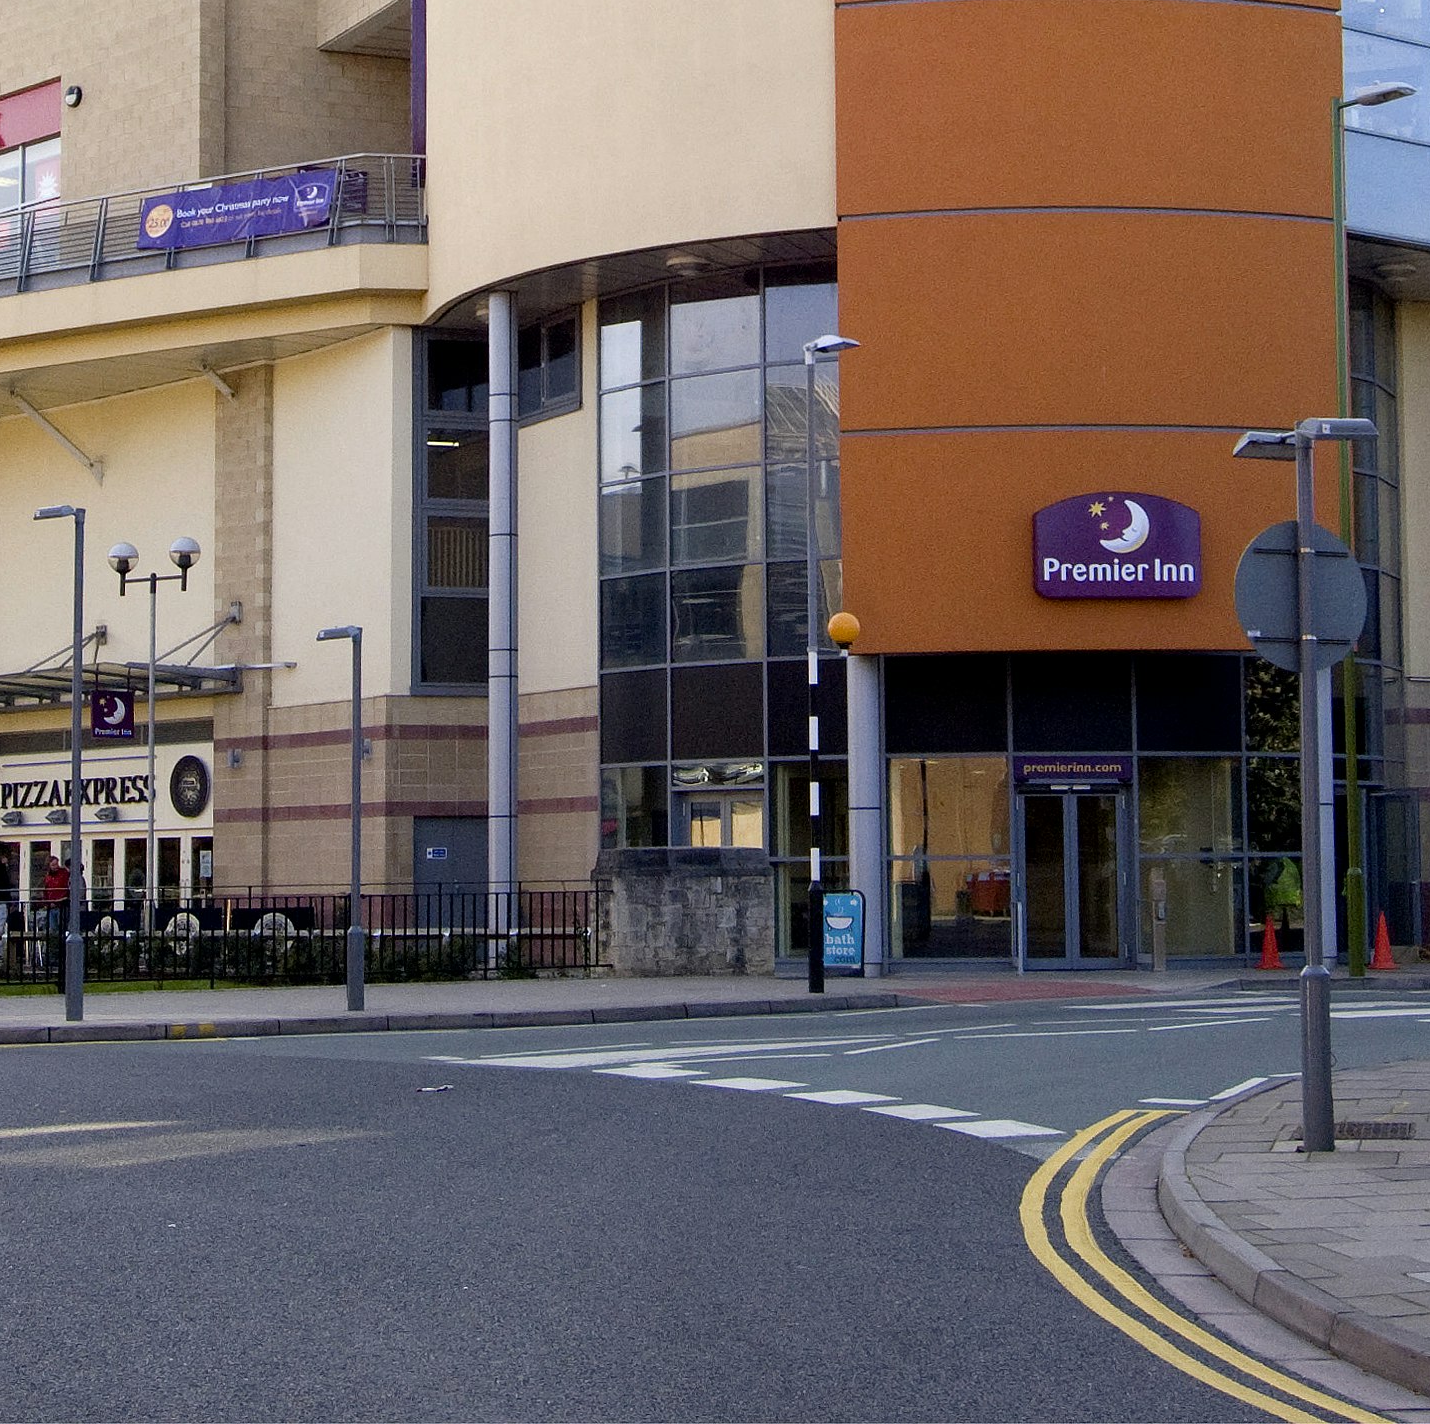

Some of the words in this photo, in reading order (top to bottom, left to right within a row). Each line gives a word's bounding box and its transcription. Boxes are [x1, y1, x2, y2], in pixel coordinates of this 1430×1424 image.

[176, 208, 196, 219] Book
[197, 207, 213, 218] your
[252, 197, 272, 208] party
[1042, 557, 1150, 582] Premier
[1153, 557, 1196, 583] Inn
[94, 727, 120, 737] Premier
[121, 727, 133, 737] Inn
[1022, 761, 1122, 776] premierinn.com
[823, 933, 856, 945] bath
[825, 945, 856, 956] store
